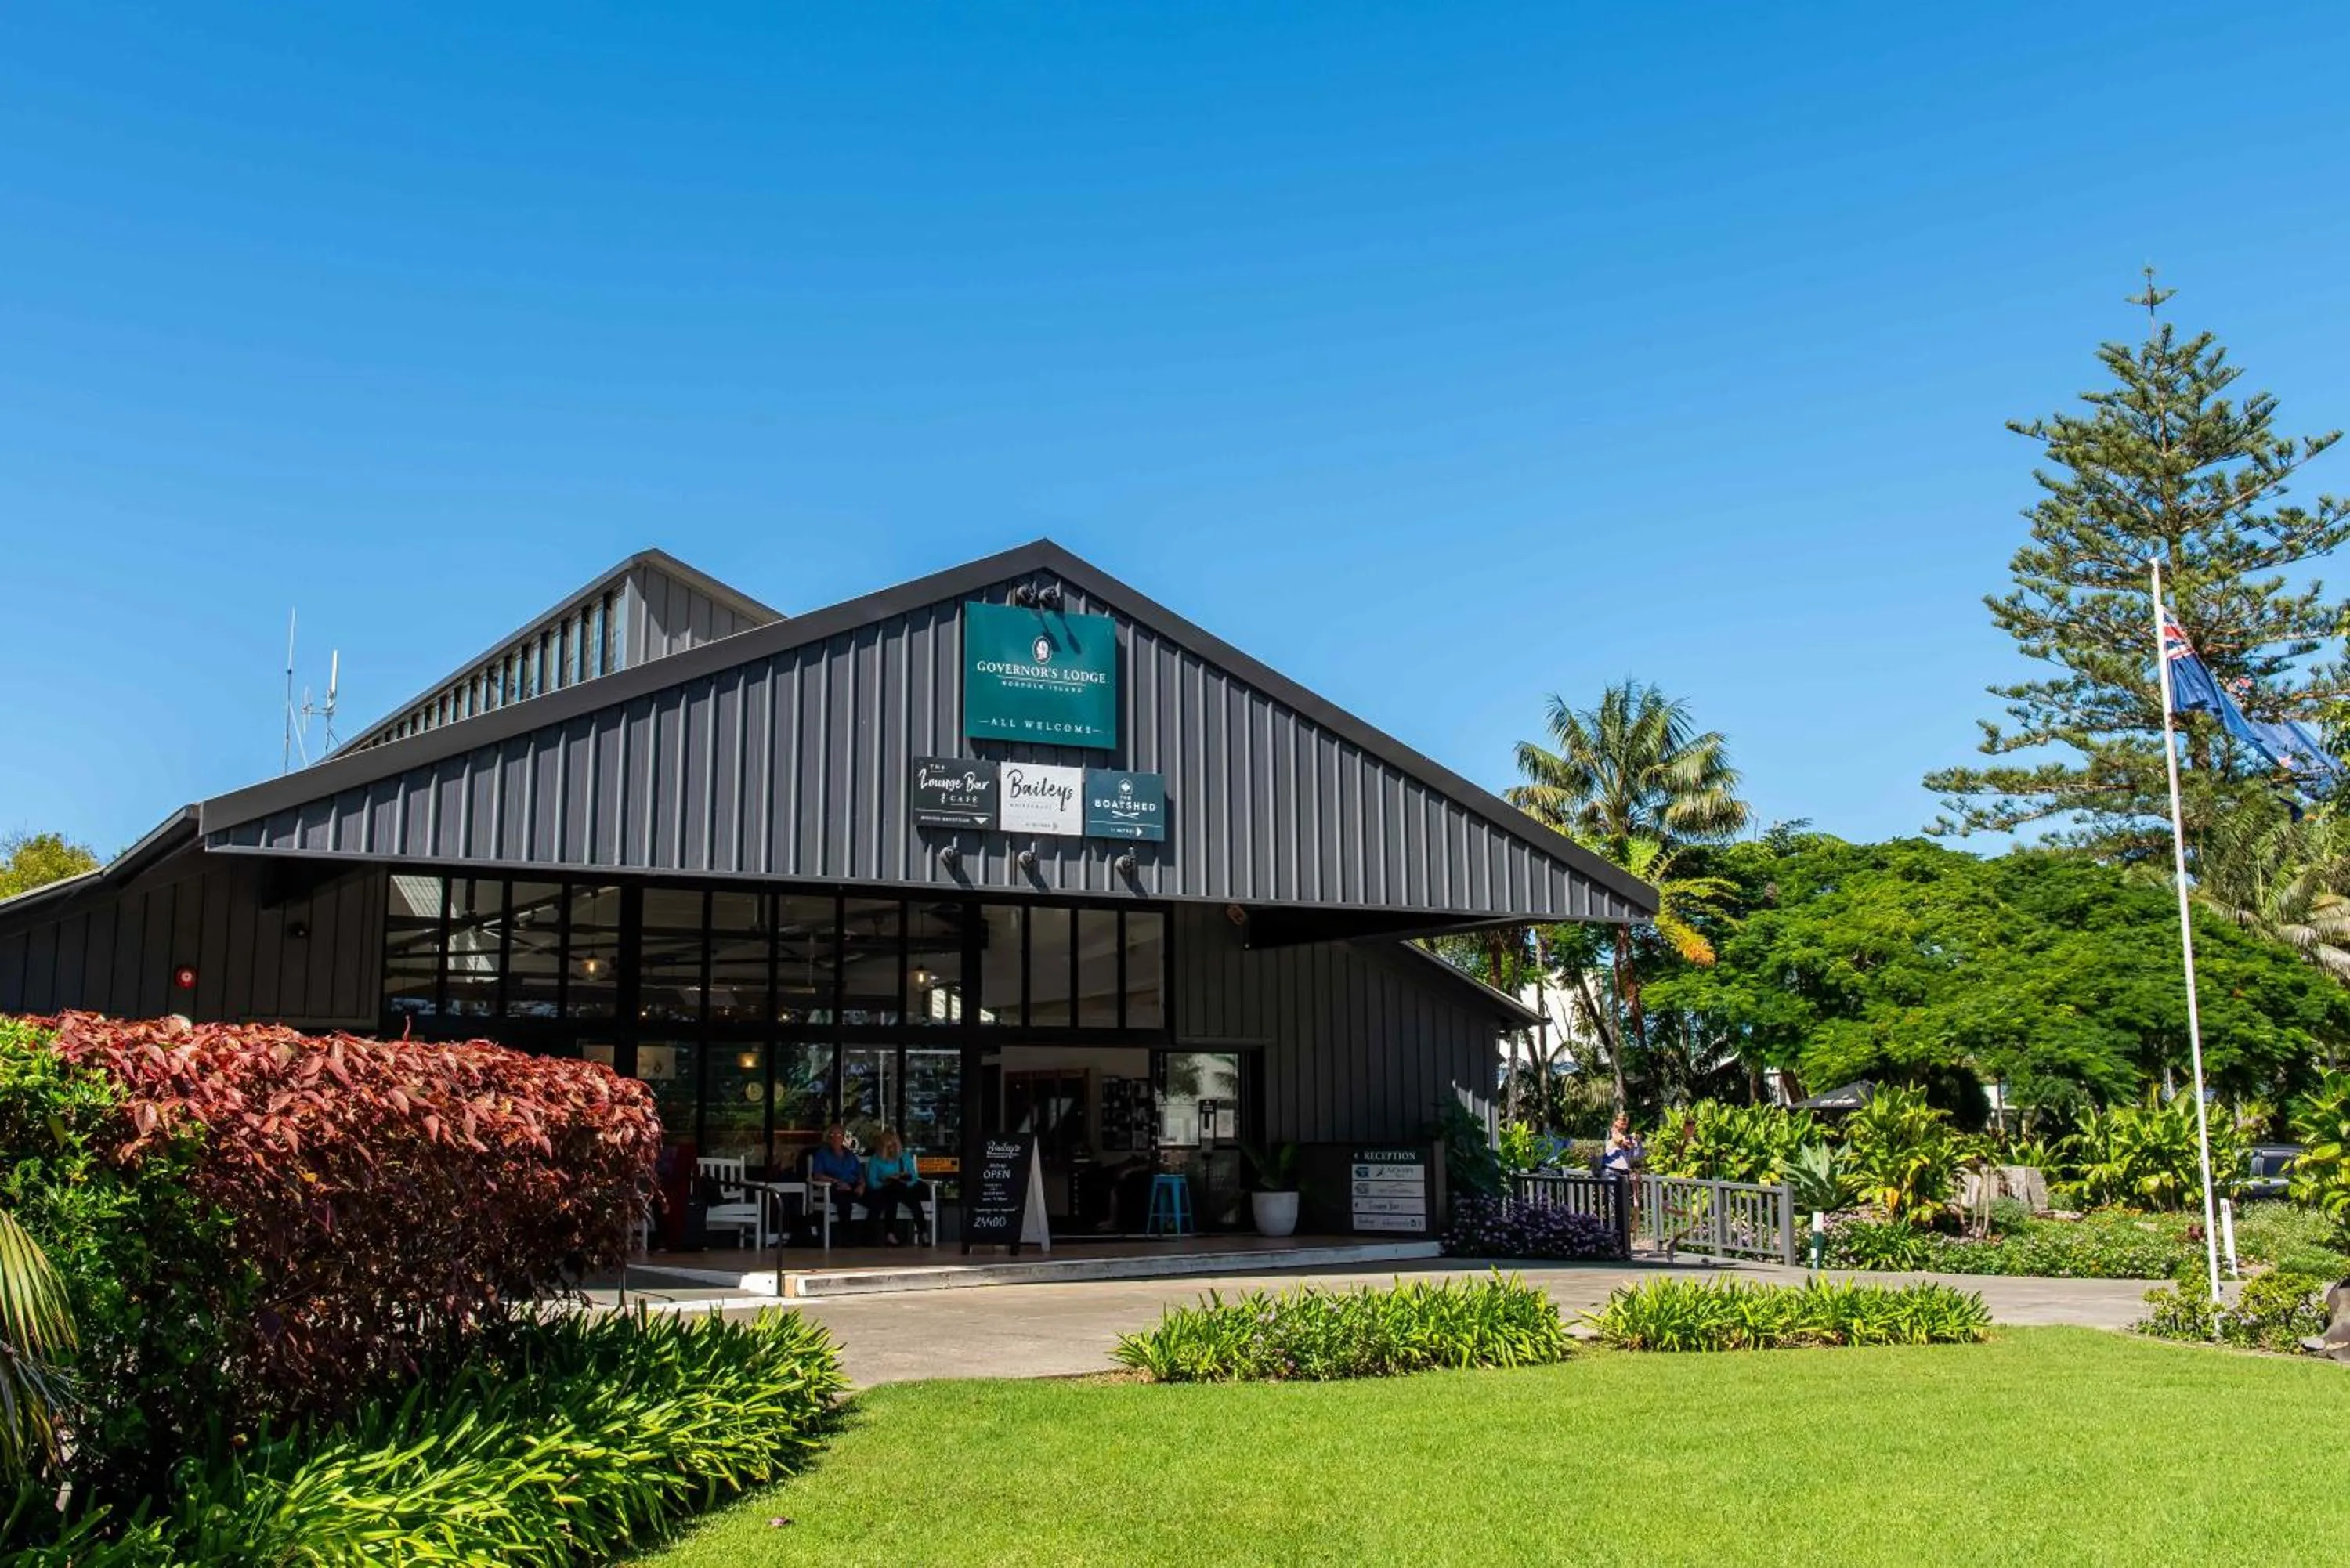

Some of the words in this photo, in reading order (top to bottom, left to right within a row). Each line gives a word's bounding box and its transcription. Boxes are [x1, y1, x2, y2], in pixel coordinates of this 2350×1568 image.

[976, 660, 1058, 679] GOVERNOR'S
[1063, 669, 1106, 683] LODGE
[991, 718, 1016, 728] ALL
[1024, 721, 1092, 735] WELCOME
[918, 768, 964, 792] Lounge
[964, 771, 990, 793] Bar
[1007, 768, 1073, 812] Baileys
[1094, 799, 1156, 812] BOATSHED
[1363, 1151, 1416, 1160] RECEPTION
[982, 1169, 1011, 1180] OPEN
